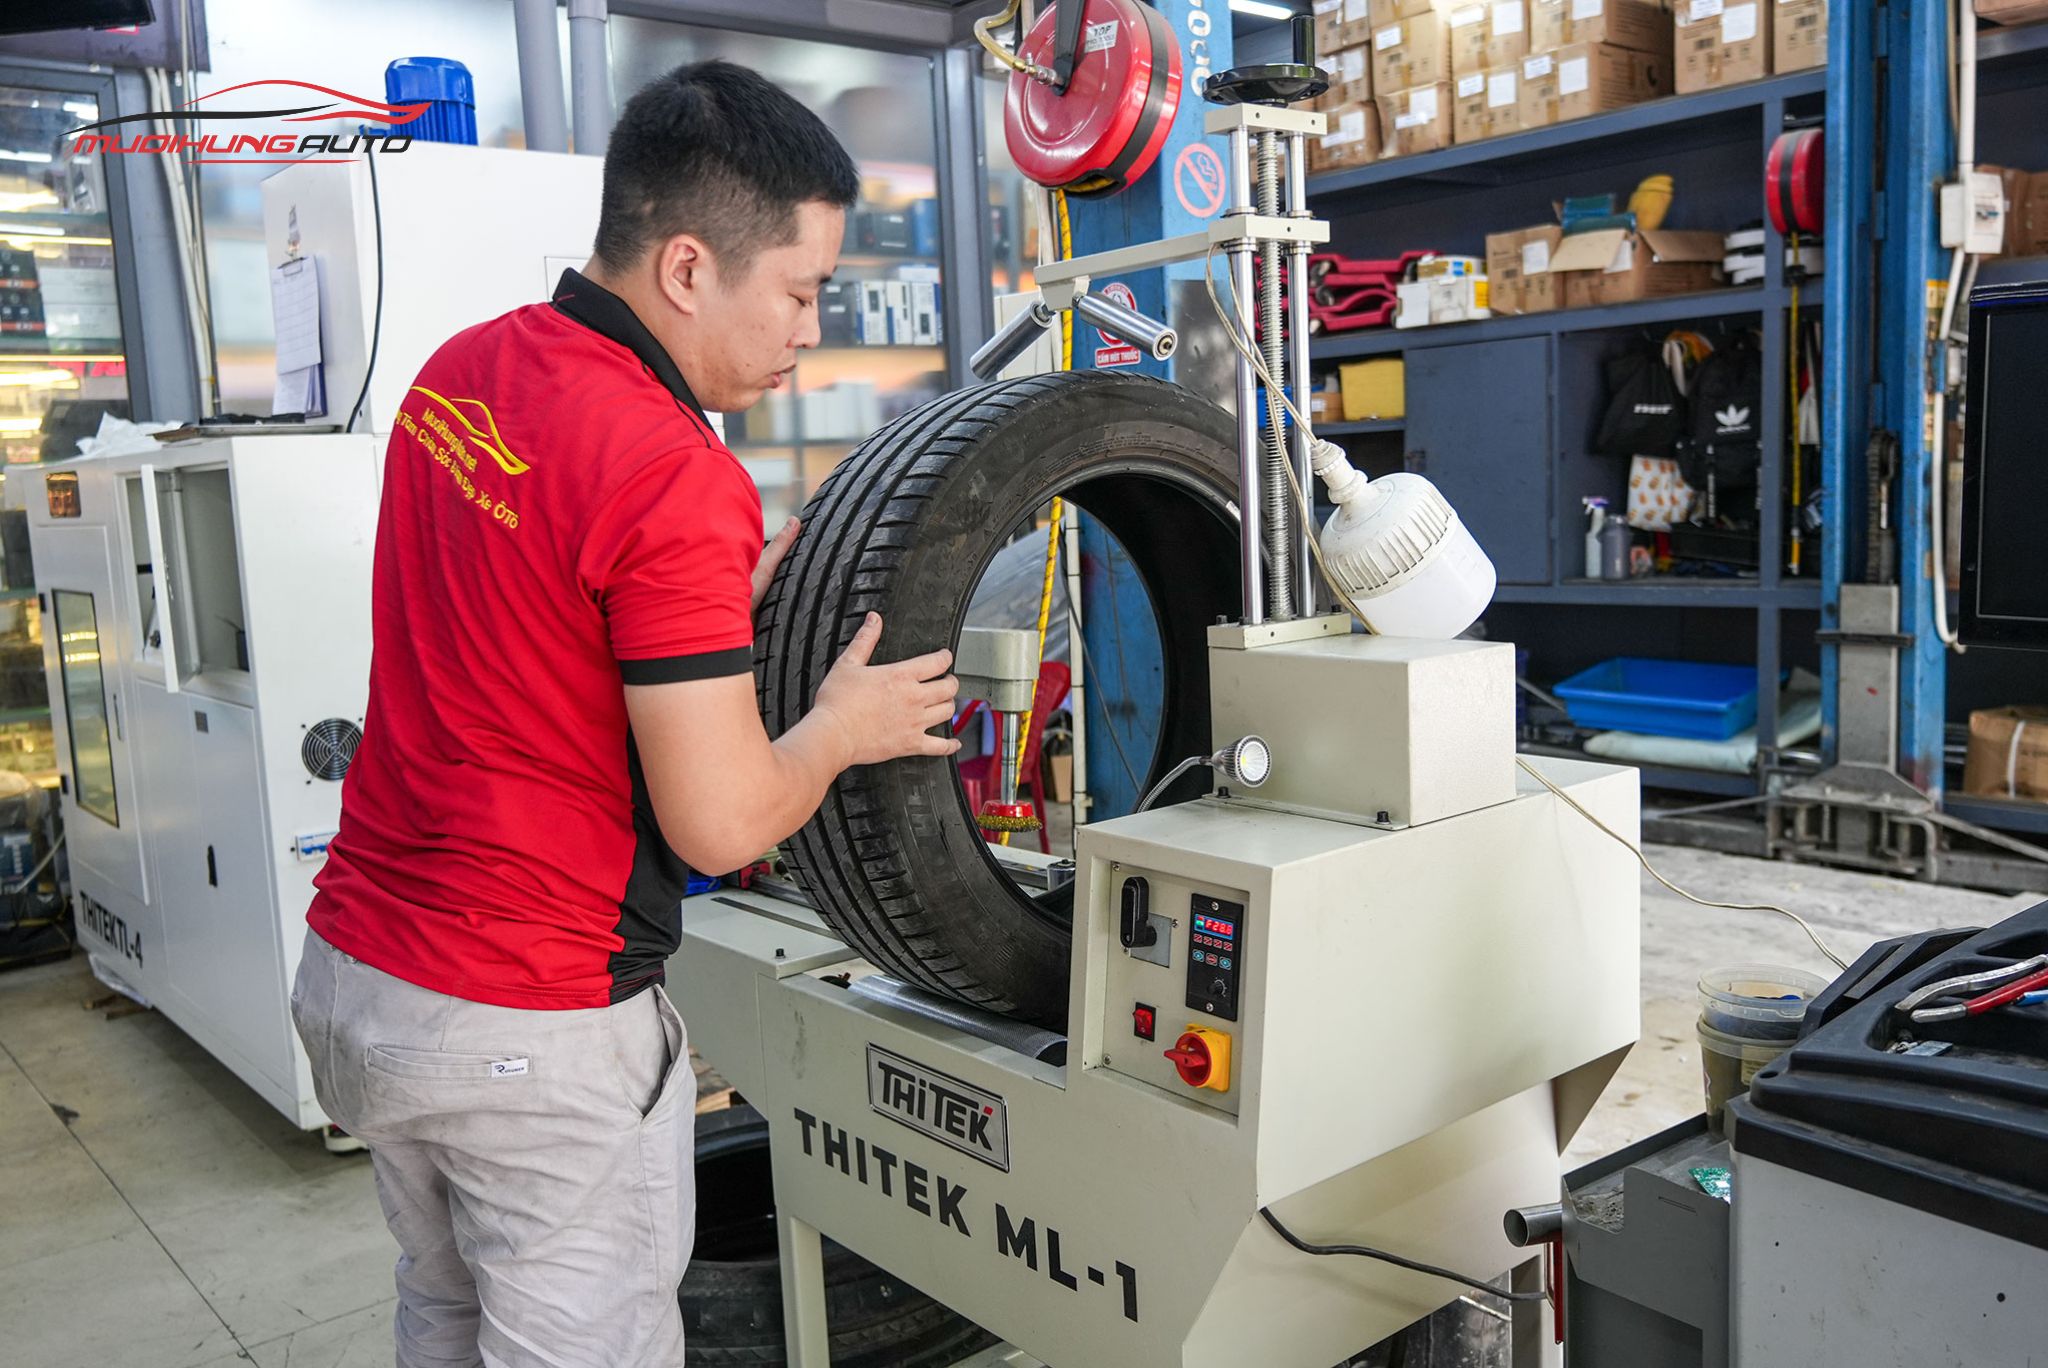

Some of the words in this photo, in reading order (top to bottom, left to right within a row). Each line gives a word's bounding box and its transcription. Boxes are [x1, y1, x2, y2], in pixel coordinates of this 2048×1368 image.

[475, 490, 493, 510] Xe
[794, 1107, 971, 1238] THITEK
[995, 1203, 1138, 1323] ML-1
